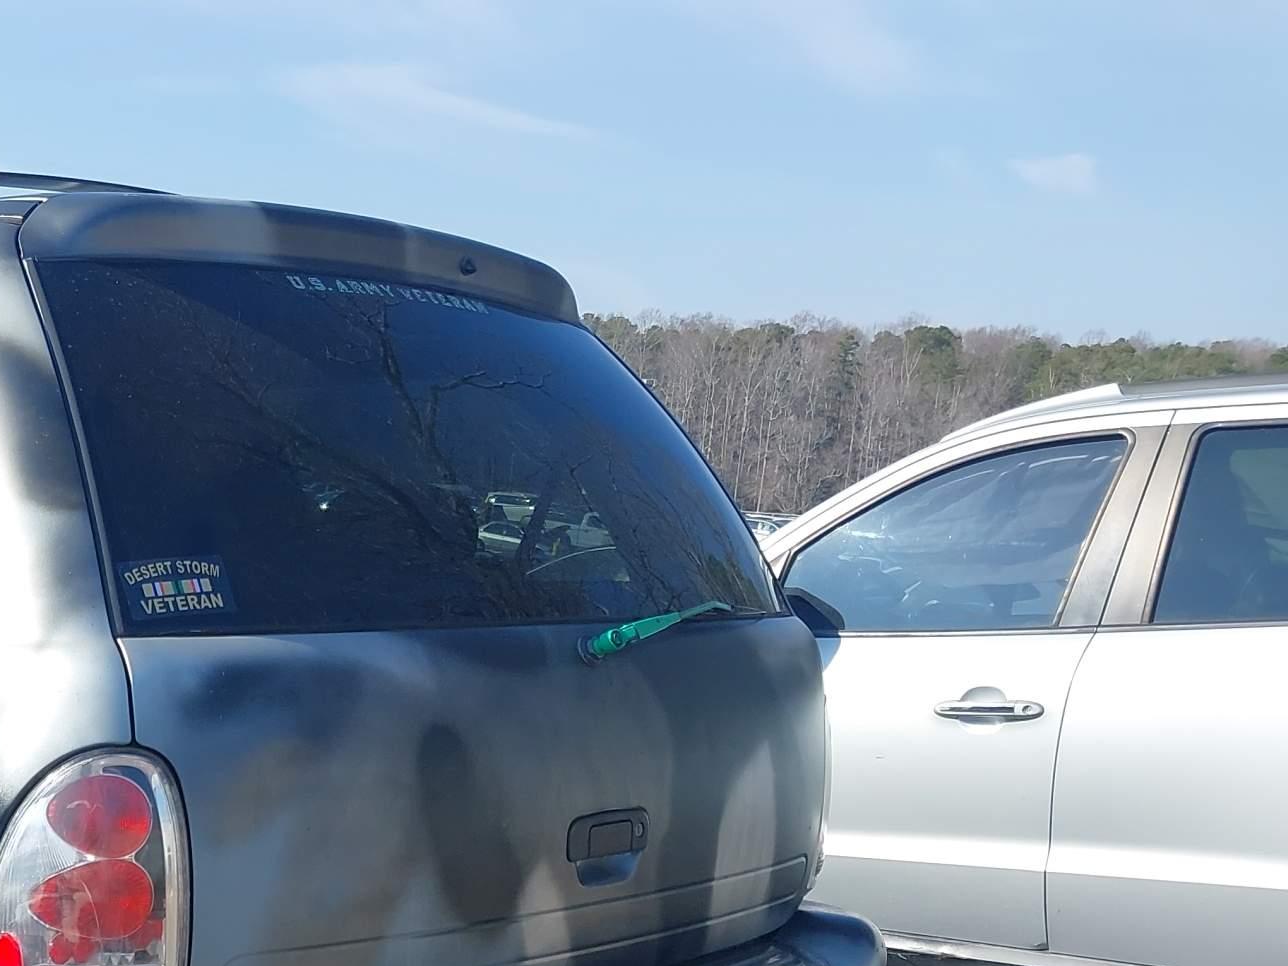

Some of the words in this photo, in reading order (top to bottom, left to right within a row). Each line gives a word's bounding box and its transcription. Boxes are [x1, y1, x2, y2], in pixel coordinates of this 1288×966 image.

[335, 278, 396, 298] ARMY
[397, 287, 489, 314] VETERAN
[123, 561, 173, 585] DESERT
[175, 560, 220, 578] STORM
[140, 592, 224, 615] VETERAN
